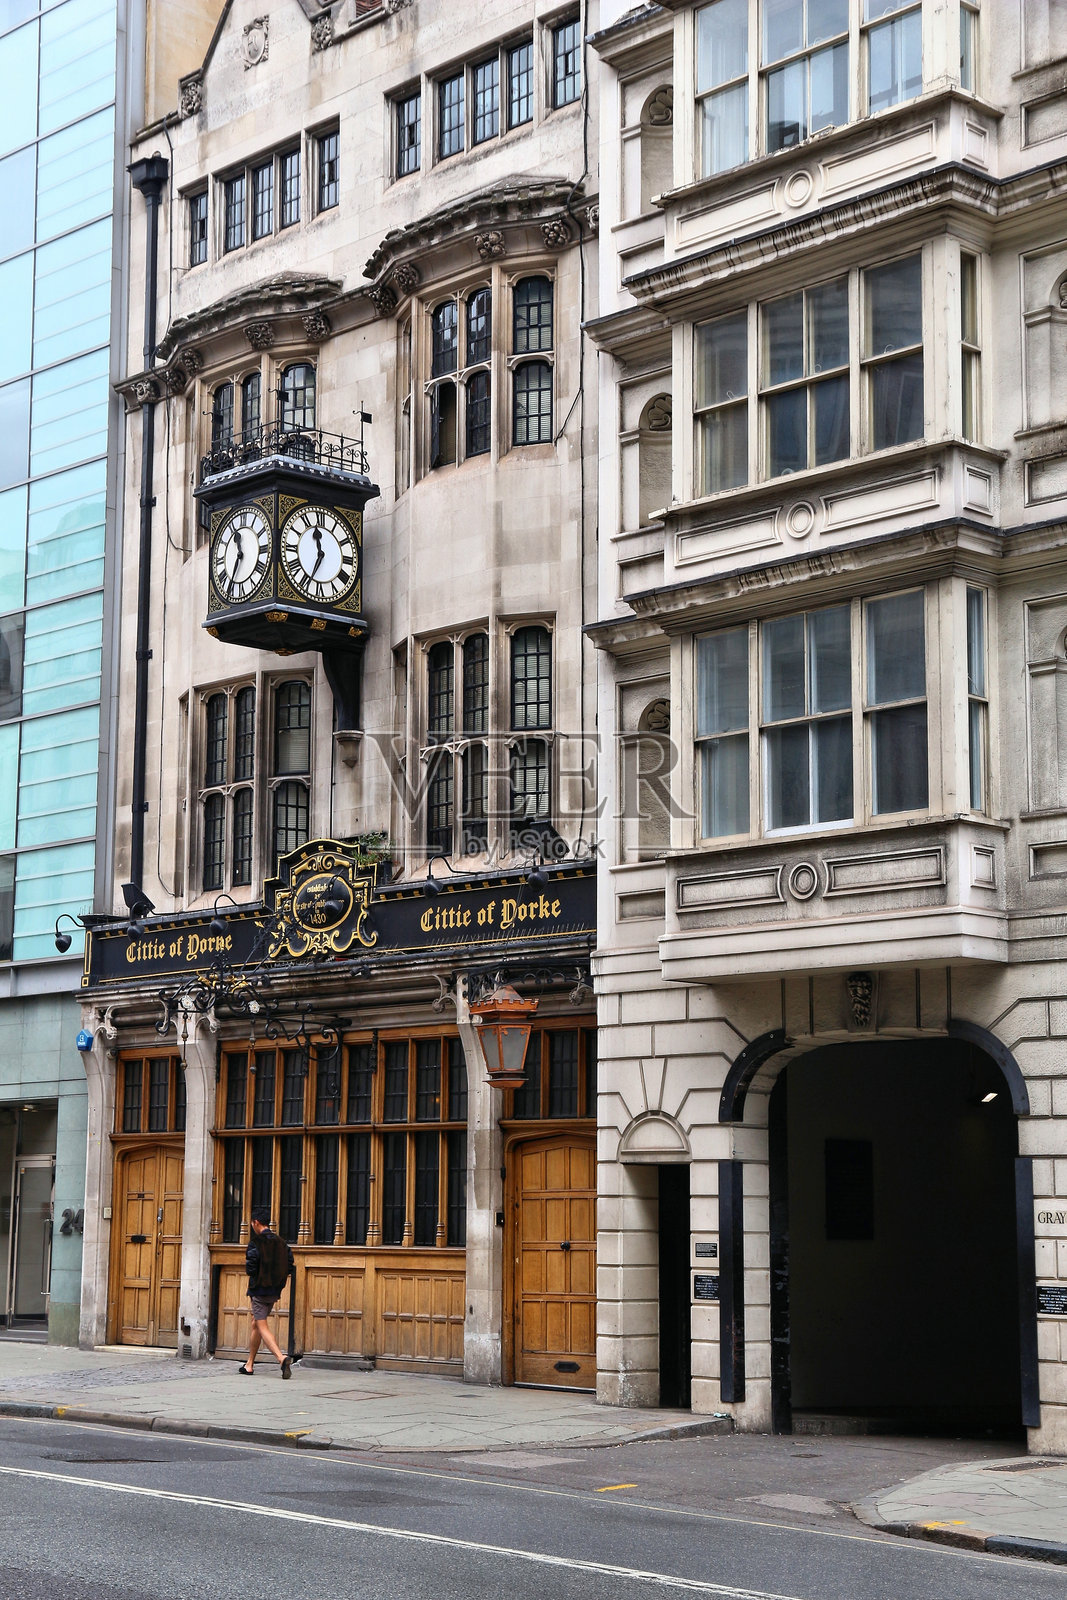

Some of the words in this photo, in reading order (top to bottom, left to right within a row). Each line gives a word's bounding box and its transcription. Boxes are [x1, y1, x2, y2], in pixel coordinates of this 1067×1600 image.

[310, 913, 326, 924] 1430
[420, 904, 472, 932] Cittie
[477, 900, 497, 926] of
[500, 893, 562, 930] Yorke
[126, 937, 166, 963] Cittie
[169, 935, 184, 957] of
[59, 1208, 85, 1233] 24
